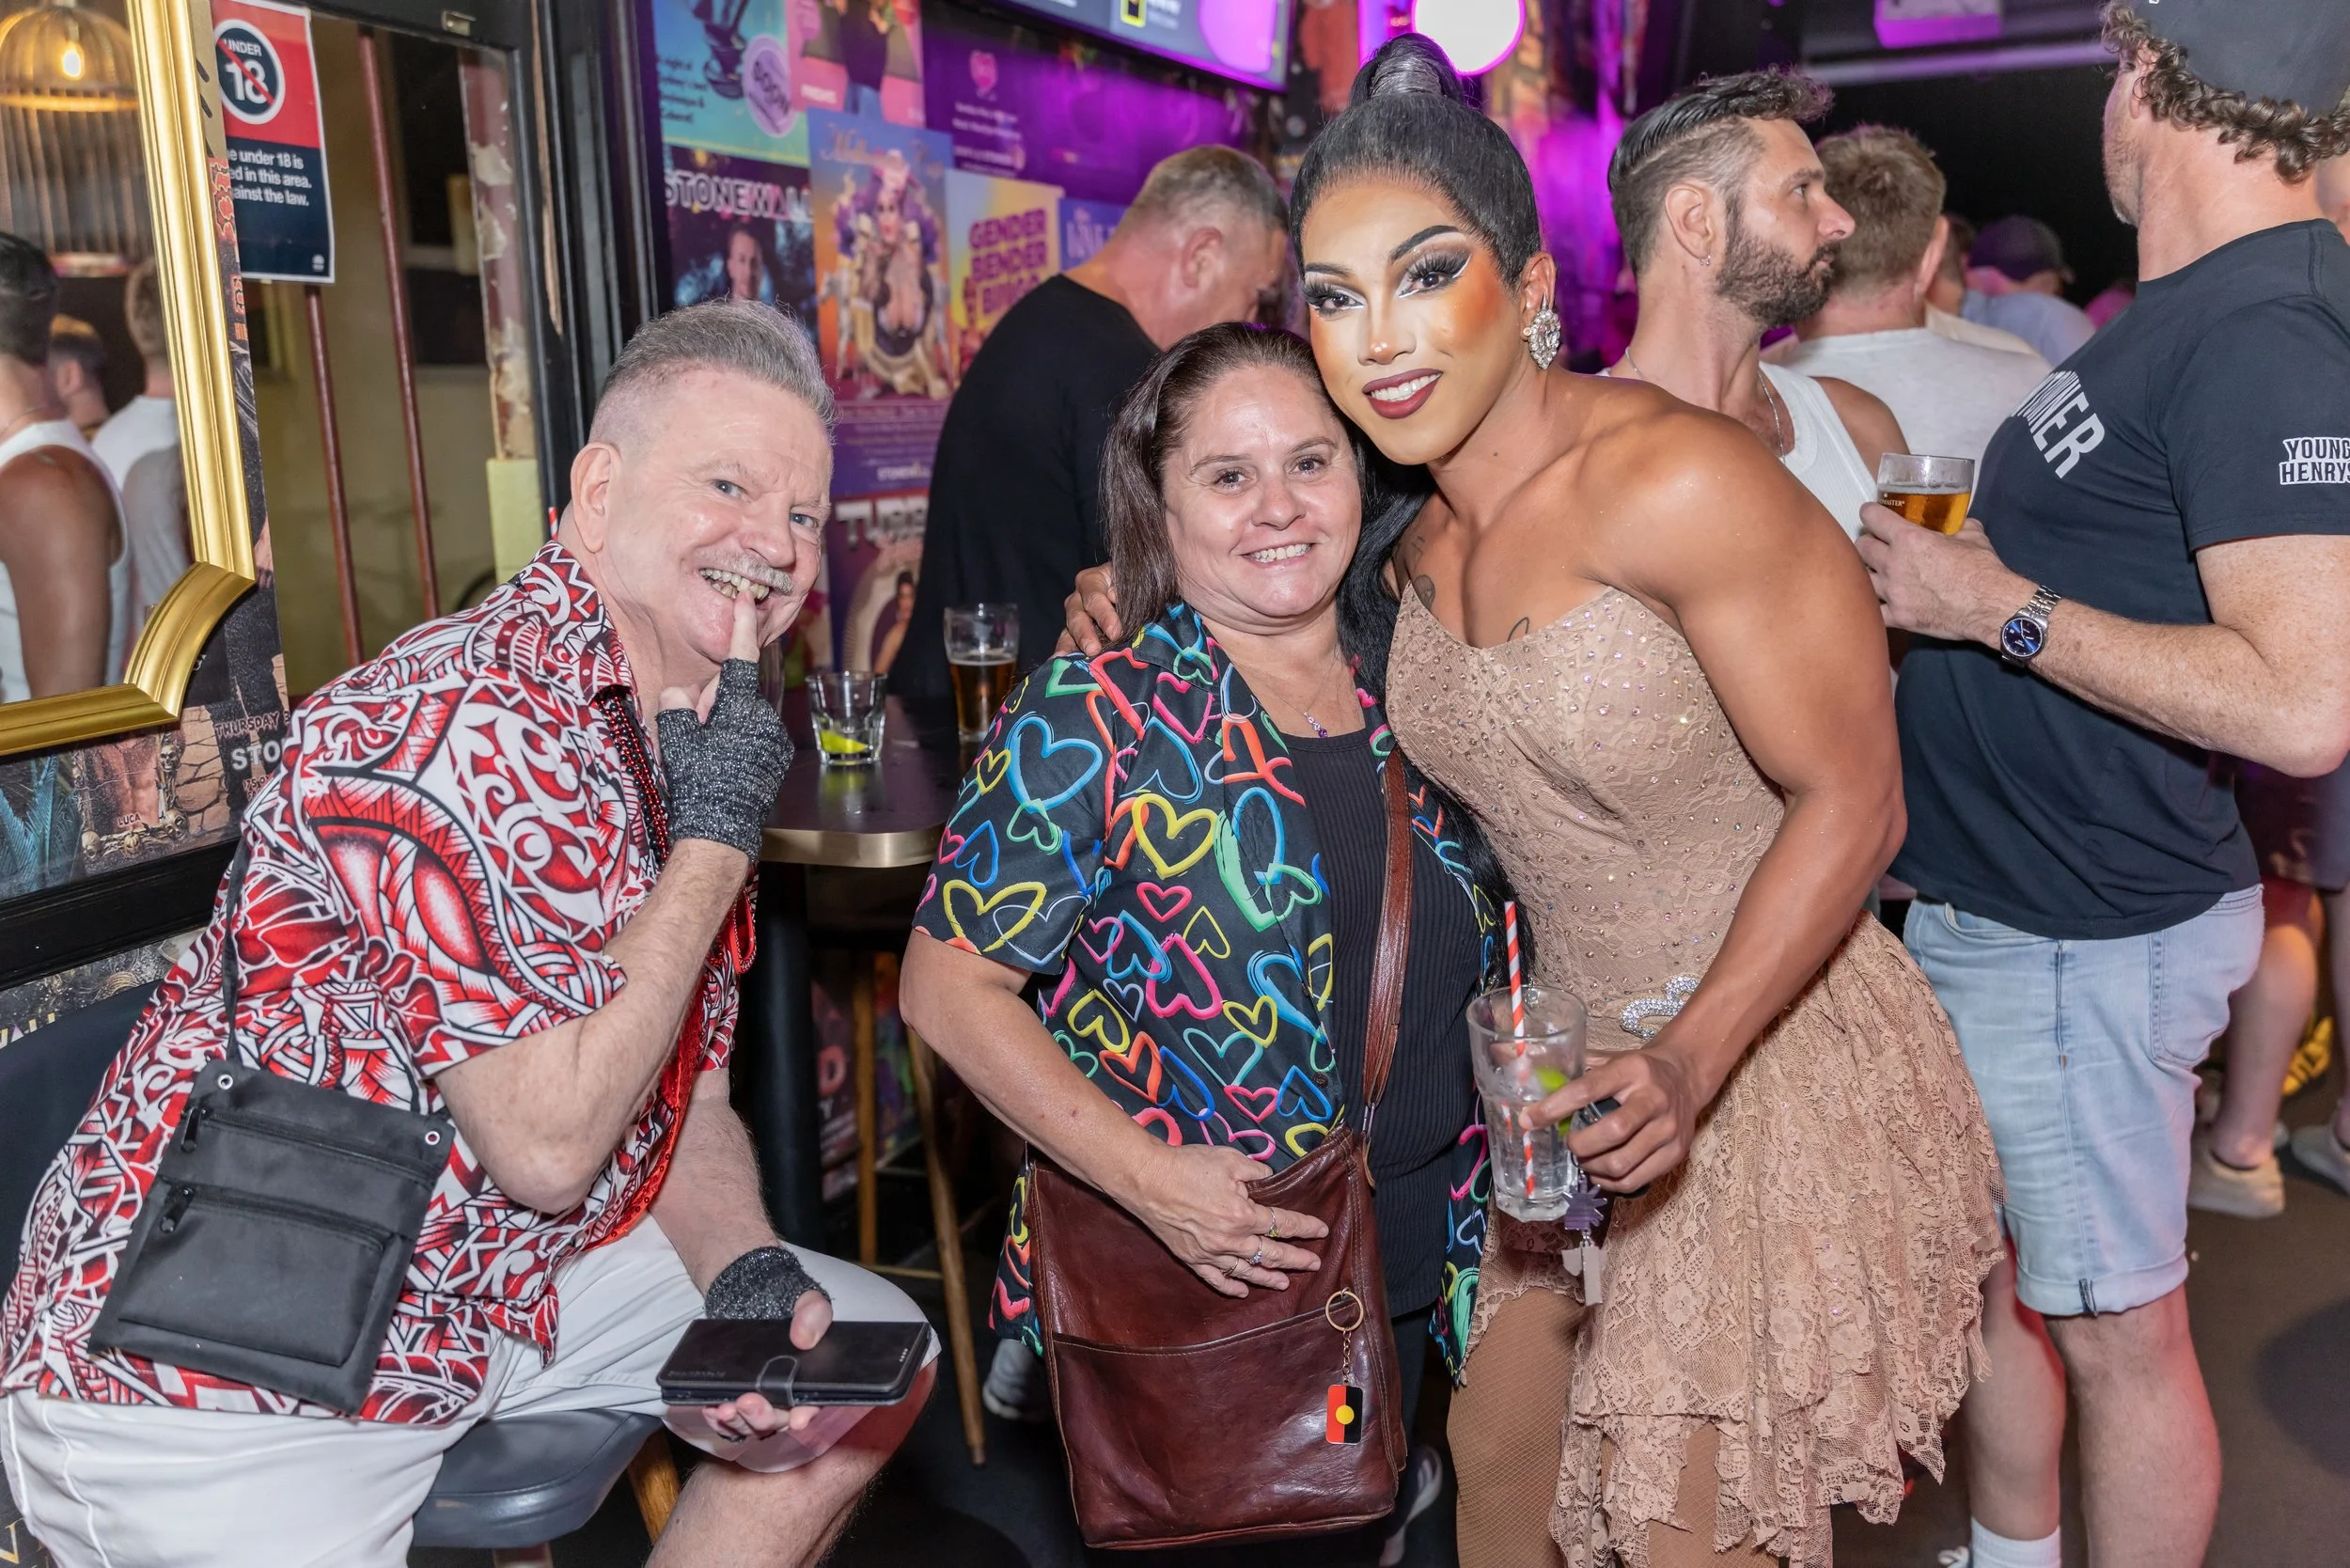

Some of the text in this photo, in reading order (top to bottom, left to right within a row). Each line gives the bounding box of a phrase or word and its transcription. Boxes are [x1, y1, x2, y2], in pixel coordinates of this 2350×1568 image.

[224, 39, 262, 56] UNDER
[225, 59, 269, 103] 18
[239, 149, 274, 165] under
[276, 151, 291, 168] 18
[292, 153, 304, 169] is
[244, 166, 257, 181] in
[258, 167, 281, 184] this
[282, 173, 312, 188] area.
[232, 184, 309, 206] ainst the law.
[969, 208, 1046, 250] GENDER
[2283, 437, 2350, 460] YOUNG
[214, 712, 280, 736] THURSDAY
[231, 740, 281, 770] STO
[118, 812, 142, 826] LUCA
